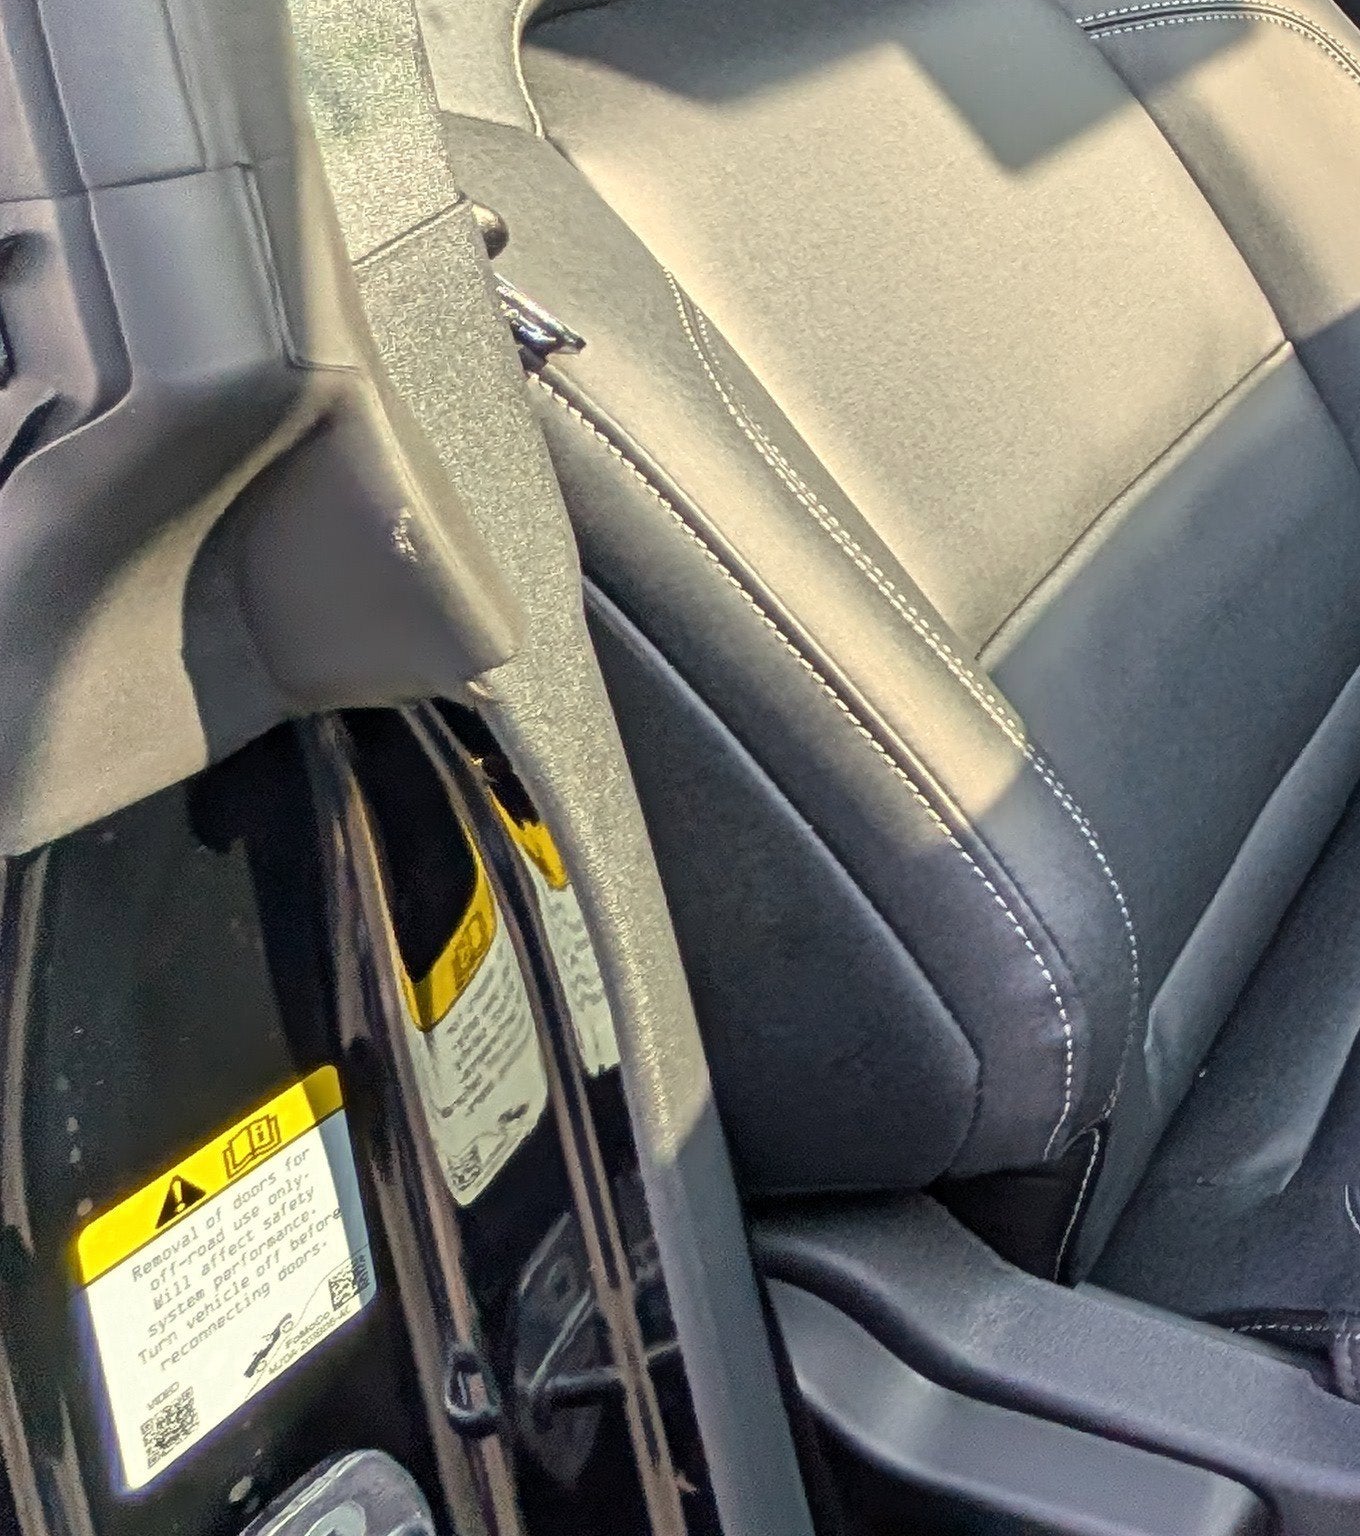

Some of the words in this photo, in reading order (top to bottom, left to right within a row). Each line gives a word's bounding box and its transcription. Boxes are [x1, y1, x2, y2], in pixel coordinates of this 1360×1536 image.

[131, 1226, 200, 1283] Removal
[206, 1206, 223, 1229] of
[233, 1172, 278, 1211] doors
[284, 1147, 311, 1172] for
[147, 1288, 206, 1338] system
[213, 1208, 316, 1290] performance.
[150, 1228, 226, 1291] off-road
[233, 1206, 260, 1231] use
[268, 1173, 310, 1206] only.
[153, 1276, 191, 1311] Will
[201, 1230, 256, 1277] affect
[263, 1185, 315, 1231] safety
[138, 1331, 179, 1365] Turn
[186, 1276, 250, 1330] vehicle
[256, 1249, 281, 1278] off
[289, 1207, 344, 1252] before
[160, 1281, 271, 1371] reconnecting
[278, 1241, 328, 1282] doors.
